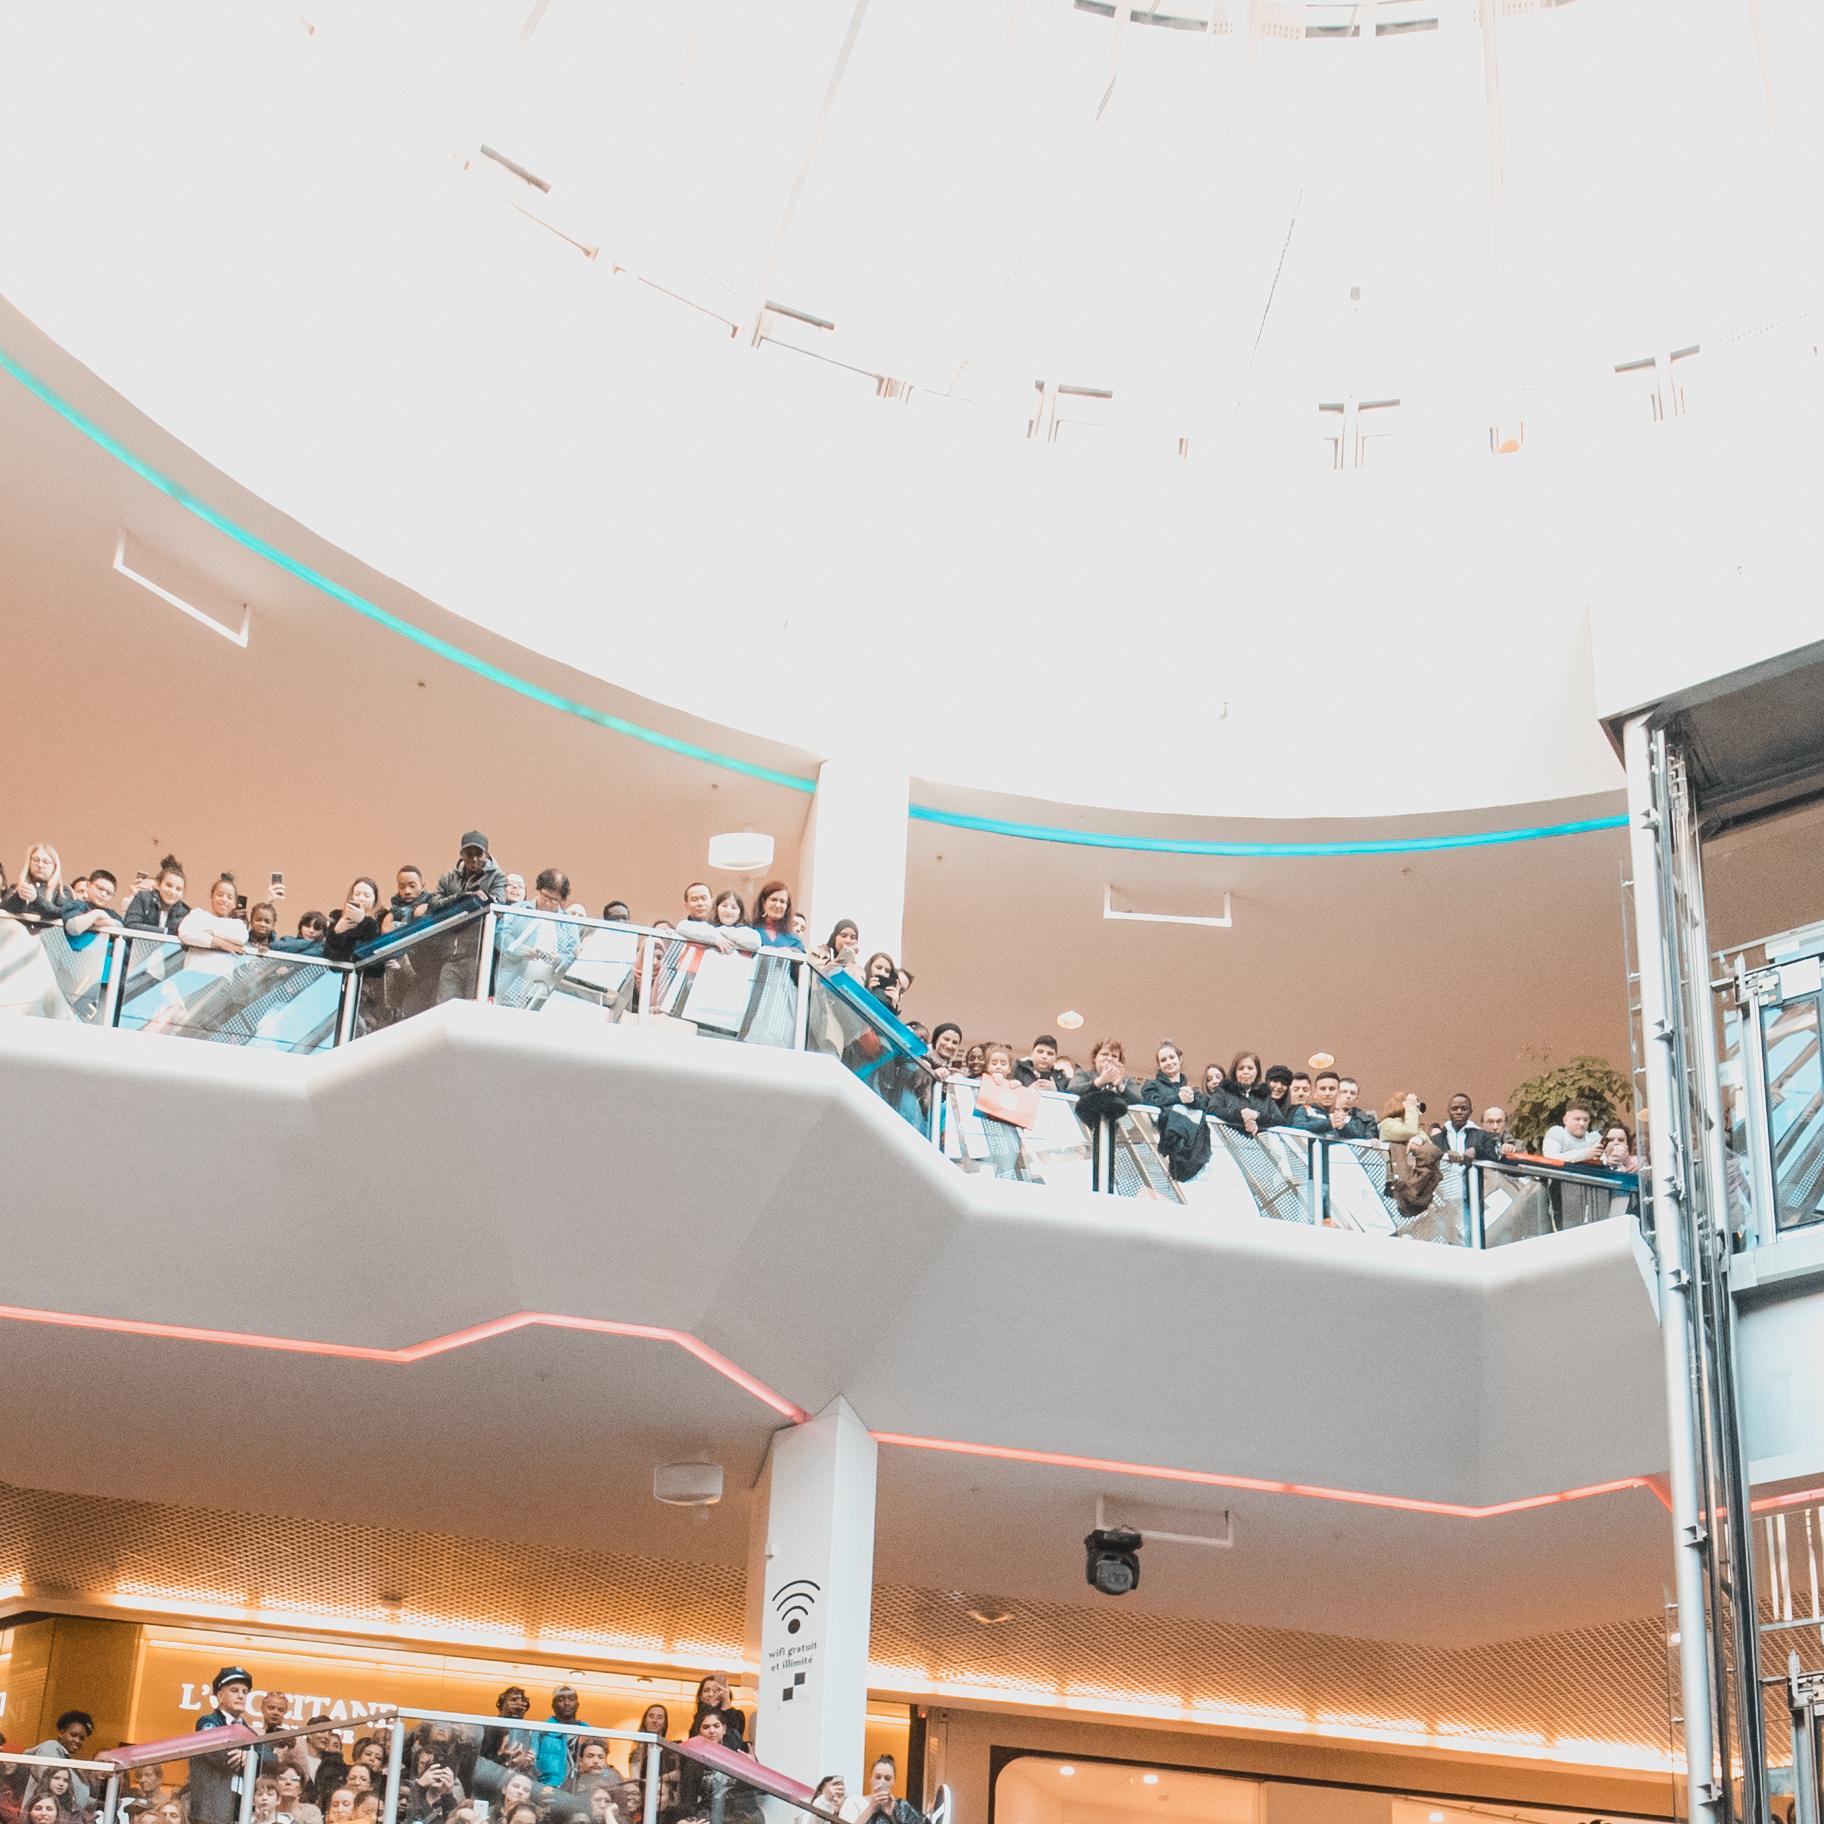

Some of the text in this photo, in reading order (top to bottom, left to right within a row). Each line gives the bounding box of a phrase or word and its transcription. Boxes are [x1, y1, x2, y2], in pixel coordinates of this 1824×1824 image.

[768, 1641, 818, 1659] wifi gratuit
[770, 1655, 814, 1672] et illimité
